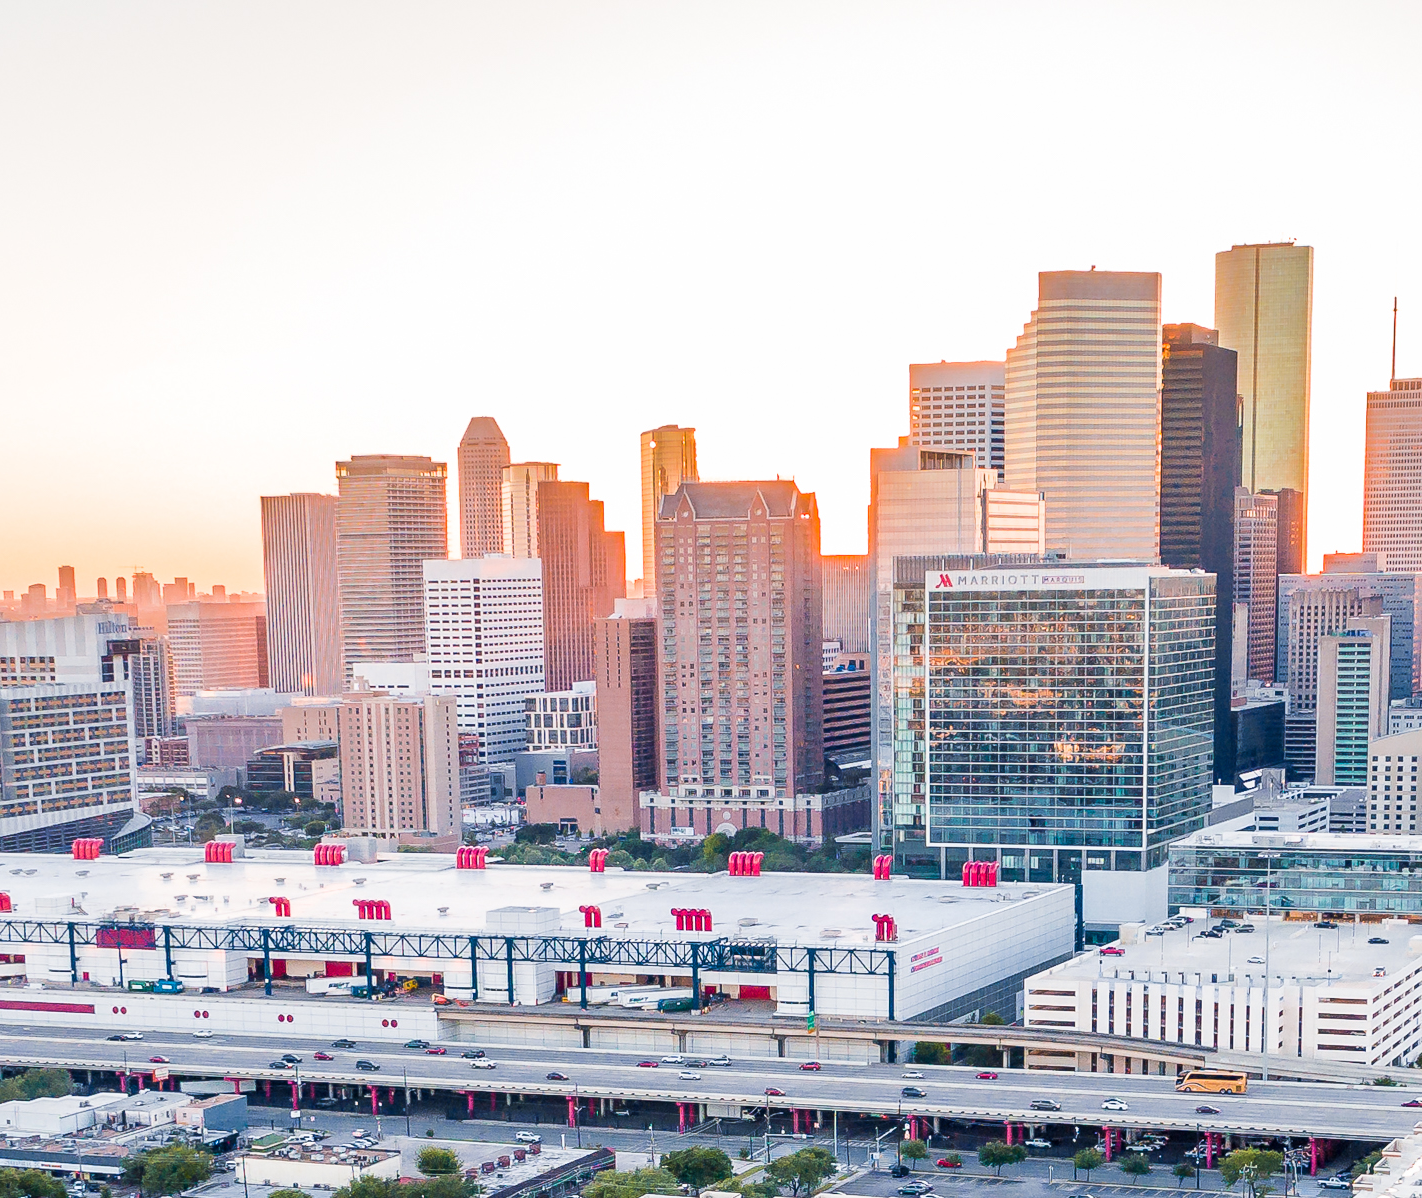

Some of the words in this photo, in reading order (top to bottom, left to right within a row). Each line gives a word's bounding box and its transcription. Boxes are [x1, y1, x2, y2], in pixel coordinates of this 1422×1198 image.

[957, 574, 1040, 586] MARRIOTT
[1043, 576, 1082, 584] MARQUIS
[98, 621, 127, 634] Hilton
